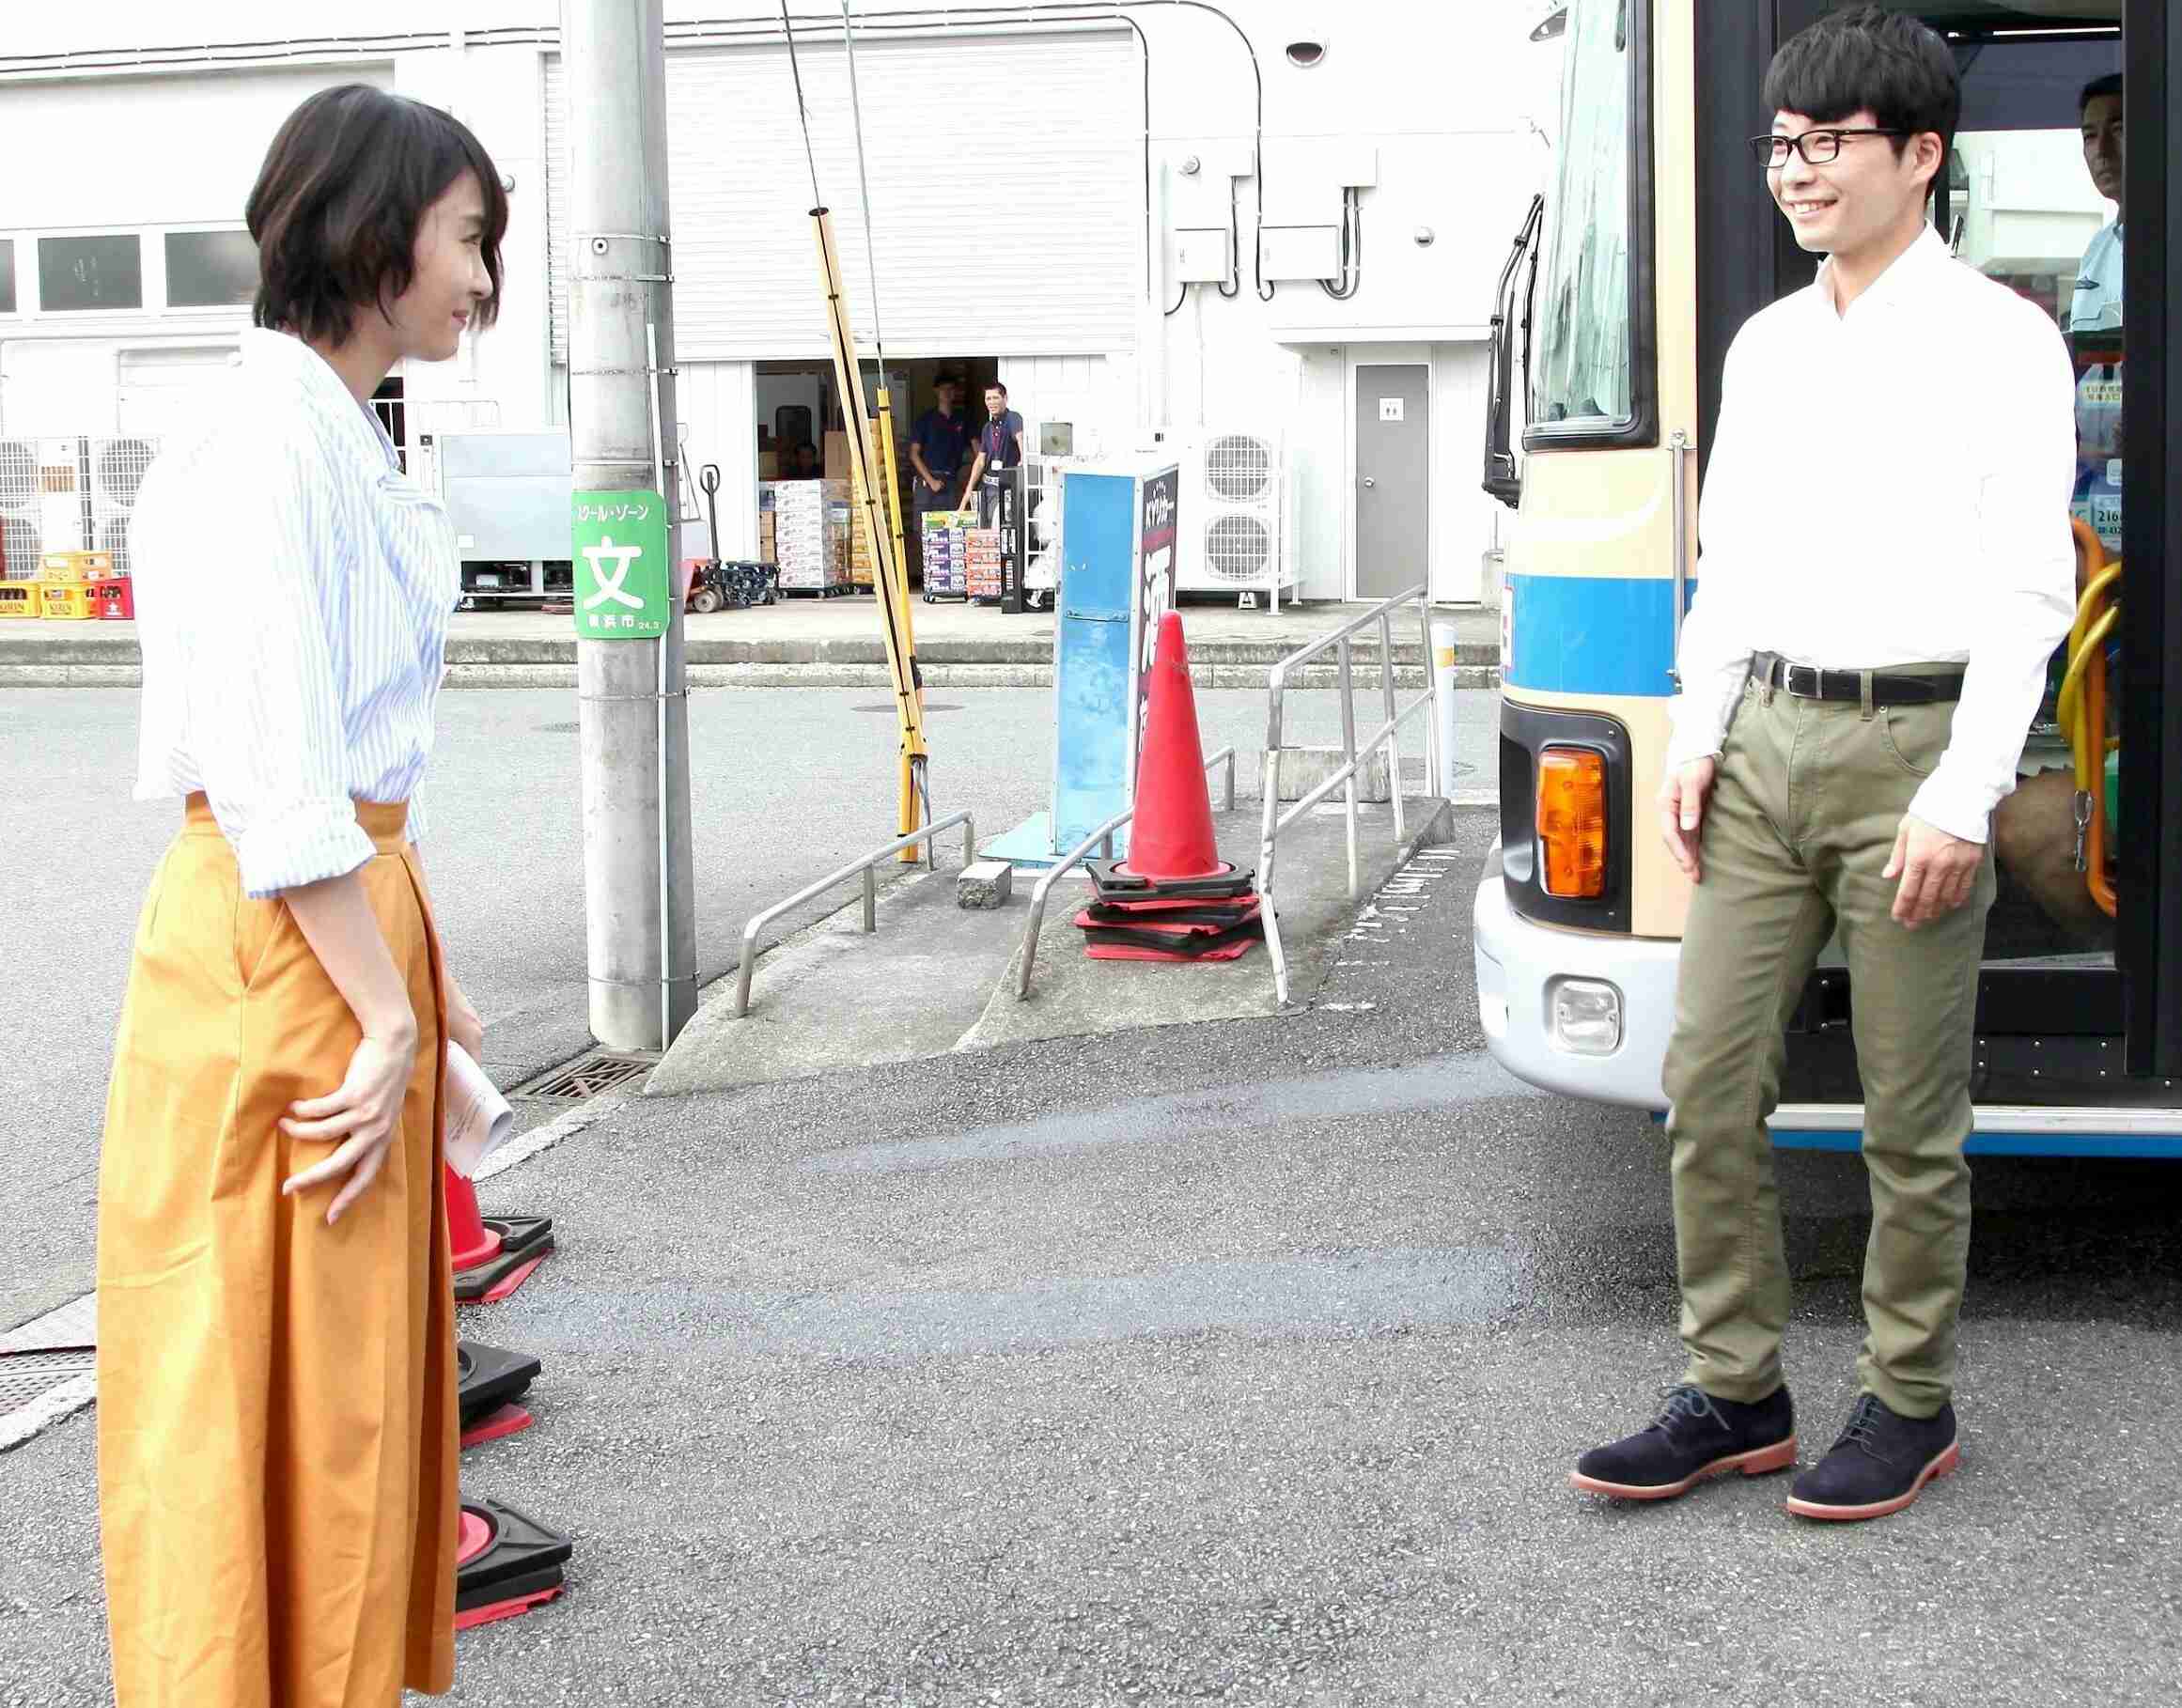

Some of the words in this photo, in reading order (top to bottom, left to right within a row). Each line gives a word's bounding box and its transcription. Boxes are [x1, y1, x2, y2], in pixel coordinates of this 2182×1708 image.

[576, 504, 649, 522] クール・ゾーン
[582, 536, 645, 610] 文
